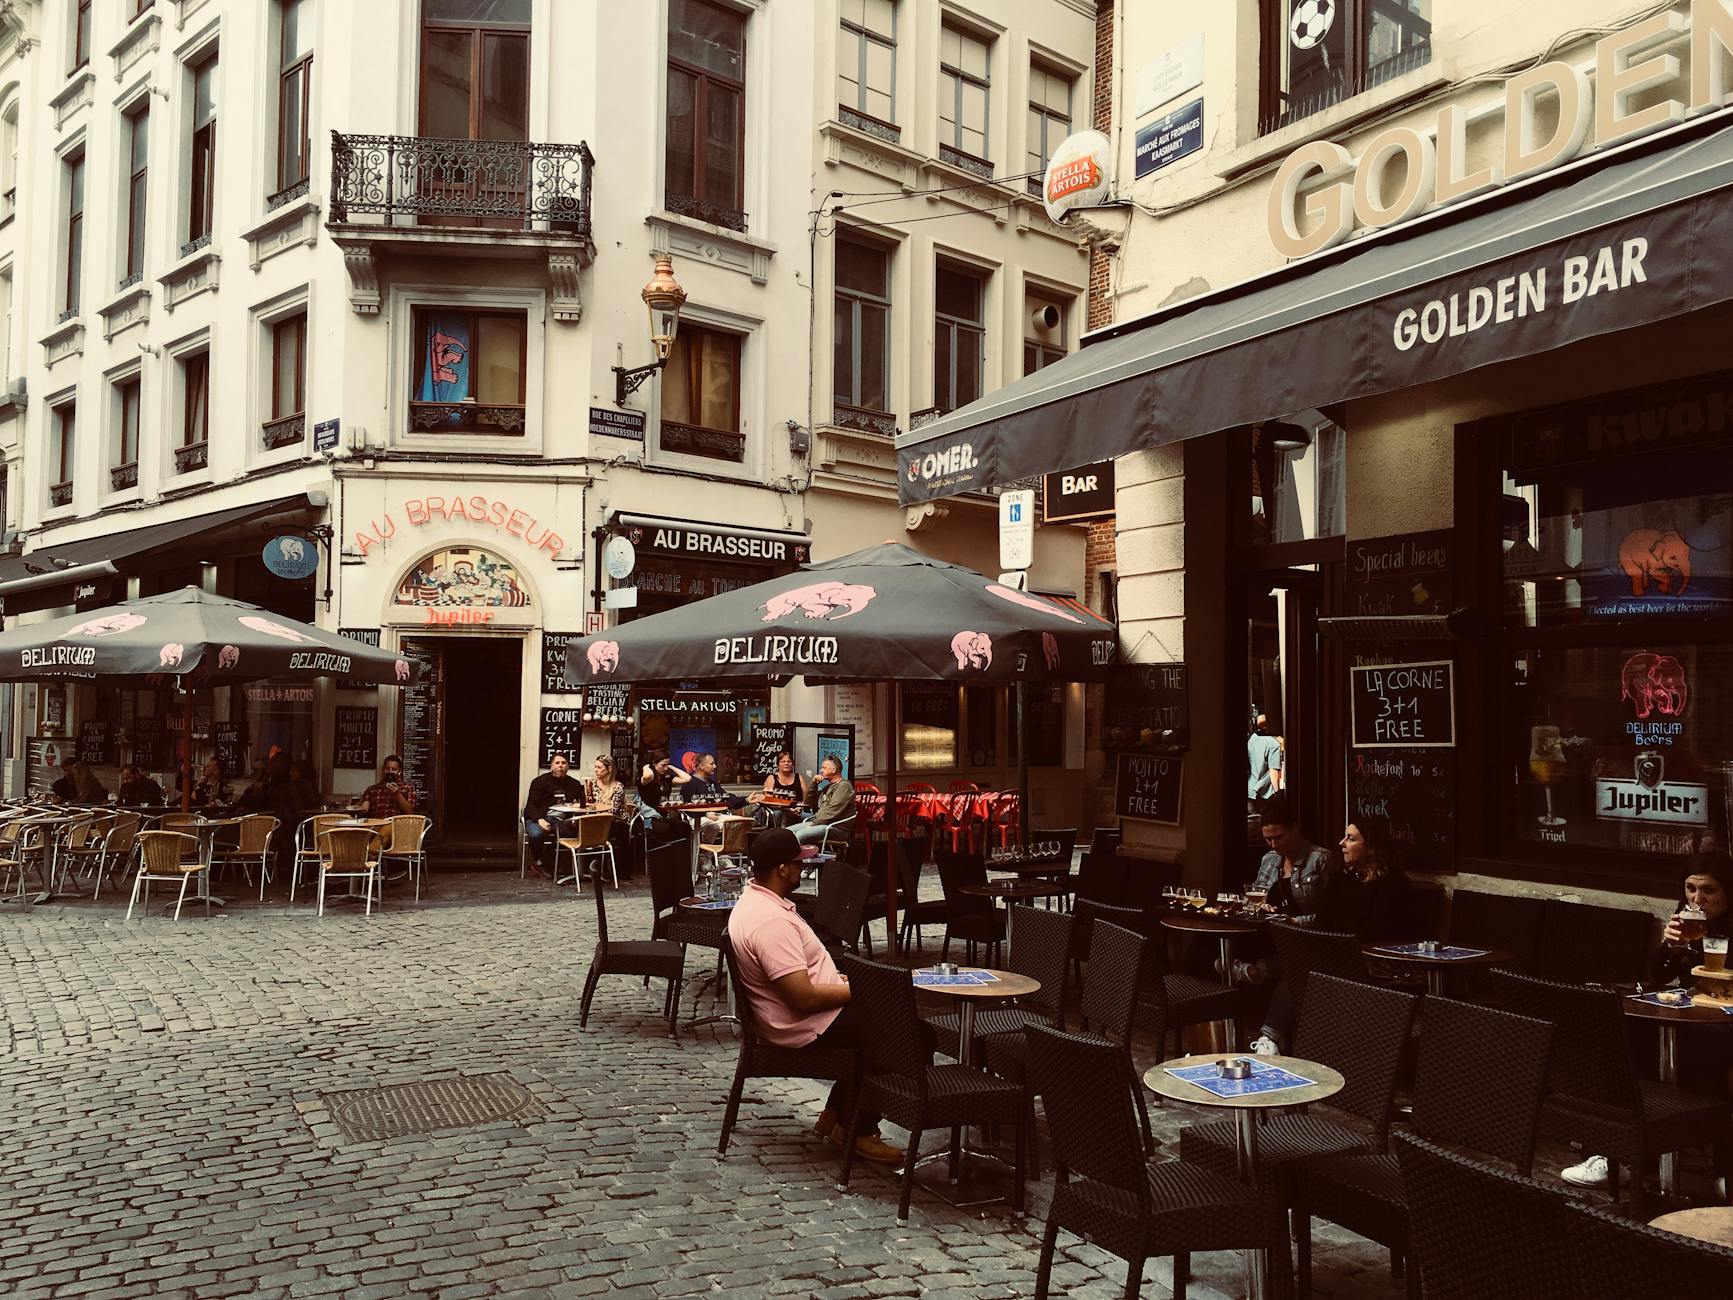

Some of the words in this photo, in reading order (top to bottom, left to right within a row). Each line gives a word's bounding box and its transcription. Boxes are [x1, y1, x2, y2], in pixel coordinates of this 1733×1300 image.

[1136, 136, 1158, 158] MARCHÉ
[1159, 132, 1171, 145] AUX
[1170, 117, 1200, 140] FROMAGES
[1152, 138, 1183, 161] KAASMARKT
[1052, 161, 1090, 181] STELLA
[1053, 172, 1090, 194] ARTOIS
[1393, 266, 1548, 351] GOLDEN
[1562, 237, 1649, 304] BAR
[602, 412, 613, 421] DES
[613, 414, 642, 427] CHAPELIERS
[1061, 475, 1098, 495] BAR
[1007, 493, 1024, 503] ZONE
[354, 513, 397, 556] AU
[405, 496, 565, 560] BRASSEUR
[653, 529, 680, 549] AU
[686, 532, 786, 560] BRASSEUR
[1355, 543, 1404, 584] Special
[424, 607, 495, 626] Jupiler
[1618, 606, 1627, 614] as
[1628, 603, 1645, 614] best
[1647, 603, 1664, 613] beer
[1666, 603, 1675, 612] in
[1678, 602, 1690, 612] the
[21, 646, 96, 668] DELIRIUM
[714, 635, 838, 664] DELIRIUM
[288, 652, 351, 674] DELIRIUM
[1161, 668, 1183, 689] THE
[1365, 670, 1384, 697] LA
[1387, 669, 1443, 690] CORNE
[248, 688, 276, 702] STELLA
[282, 687, 314, 702] ARTOIS
[587, 697, 627, 707] BELGIAN
[641, 699, 687, 711] STELLA
[690, 701, 737, 712] ARTOIS
[1378, 695, 1418, 717] 3+1
[545, 710, 578, 723] CORNE
[755, 728, 785, 739] PROMO
[1375, 719, 1424, 742] FREE
[1626, 722, 1683, 734] DELIRIUM
[545, 731, 573, 747] 3+1
[1635, 734, 1673, 745] Beers
[82, 752, 104, 762] FREE
[338, 750, 371, 764] FREE
[1128, 757, 1169, 778] MOJITO
[1135, 777, 1159, 795] 2+1
[1128, 796, 1158, 815] FREE
[1602, 787, 1698, 816] Jupiler
[1537, 828, 1567, 842] Tripel
